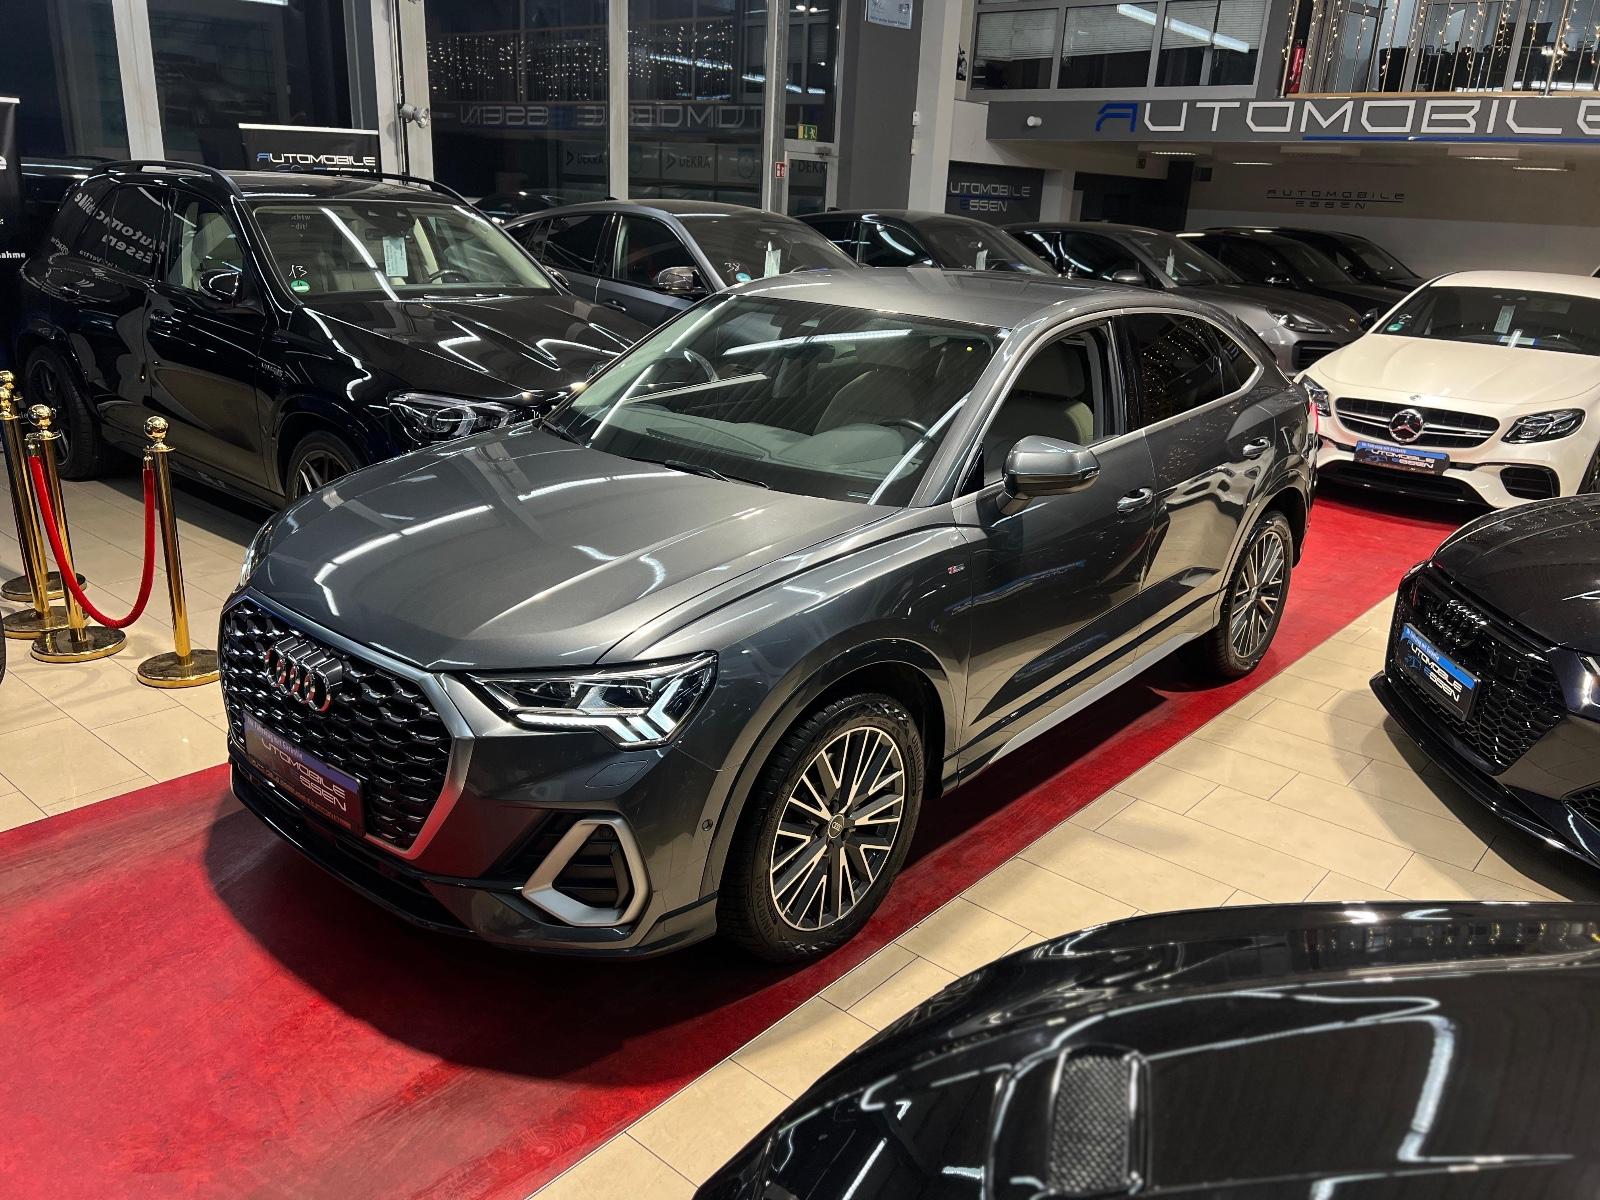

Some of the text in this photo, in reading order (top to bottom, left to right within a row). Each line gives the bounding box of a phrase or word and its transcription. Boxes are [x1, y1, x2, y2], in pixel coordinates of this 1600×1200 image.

[256, 152, 376, 166] AUTOMOBILE
[798, 161, 827, 174] DEKR
[950, 181, 1032, 197] UTOMOBILE
[1266, 189, 1405, 200] AUTOMOBILE
[1295, 200, 1366, 210] ESSEN
[261, 737, 346, 800] UTOMOBILE
[299, 775, 347, 812] SSEN
